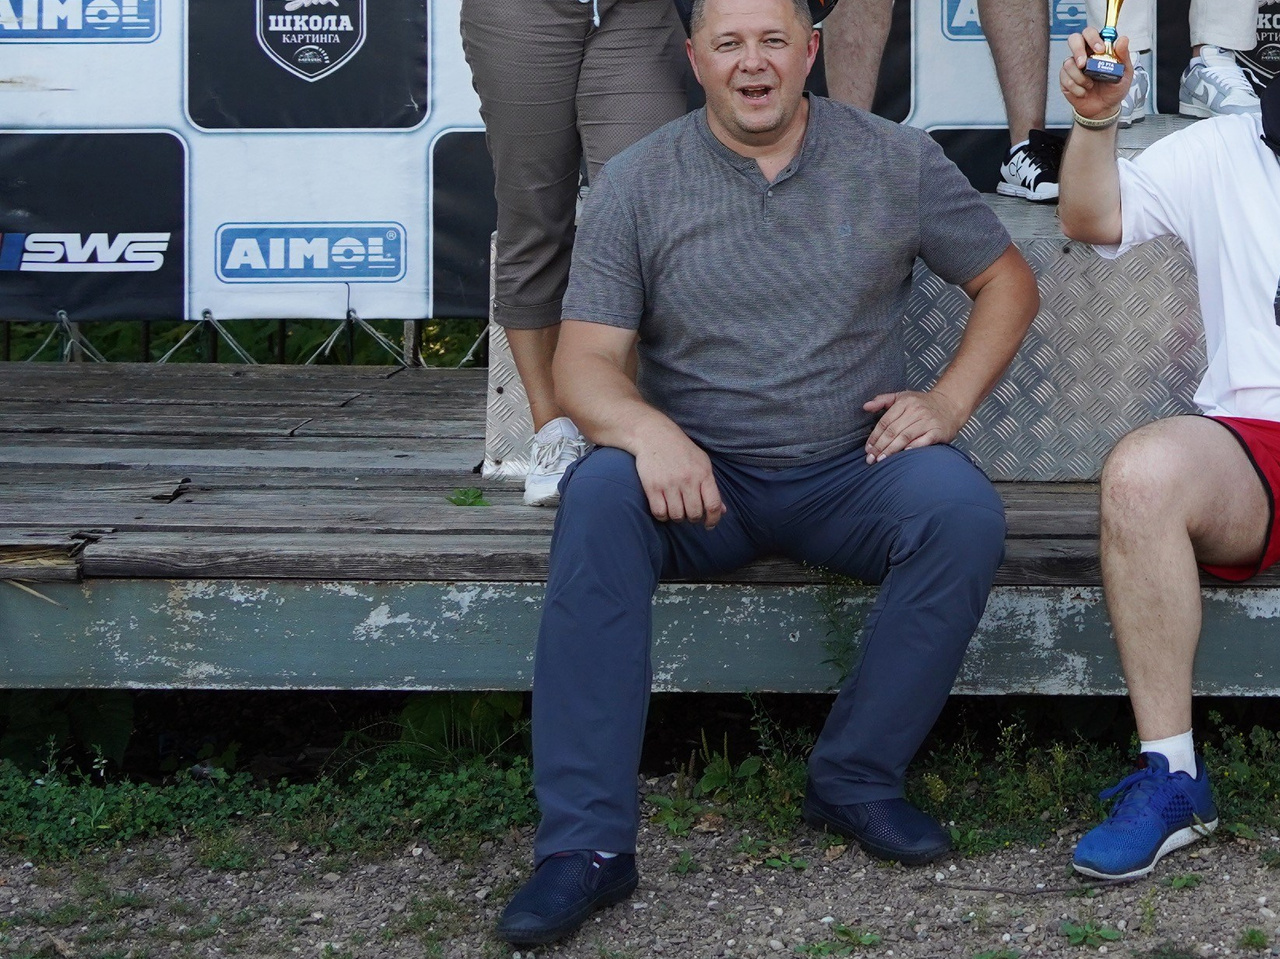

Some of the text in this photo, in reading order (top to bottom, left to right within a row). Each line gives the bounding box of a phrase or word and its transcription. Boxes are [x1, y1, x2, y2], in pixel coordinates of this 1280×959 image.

[269, 15, 353, 32] ШКОЛА
[282, 34, 341, 44] КАРТИНГА
[20, 233, 171, 272] SWS
[225, 237, 396, 270] AIMOL
